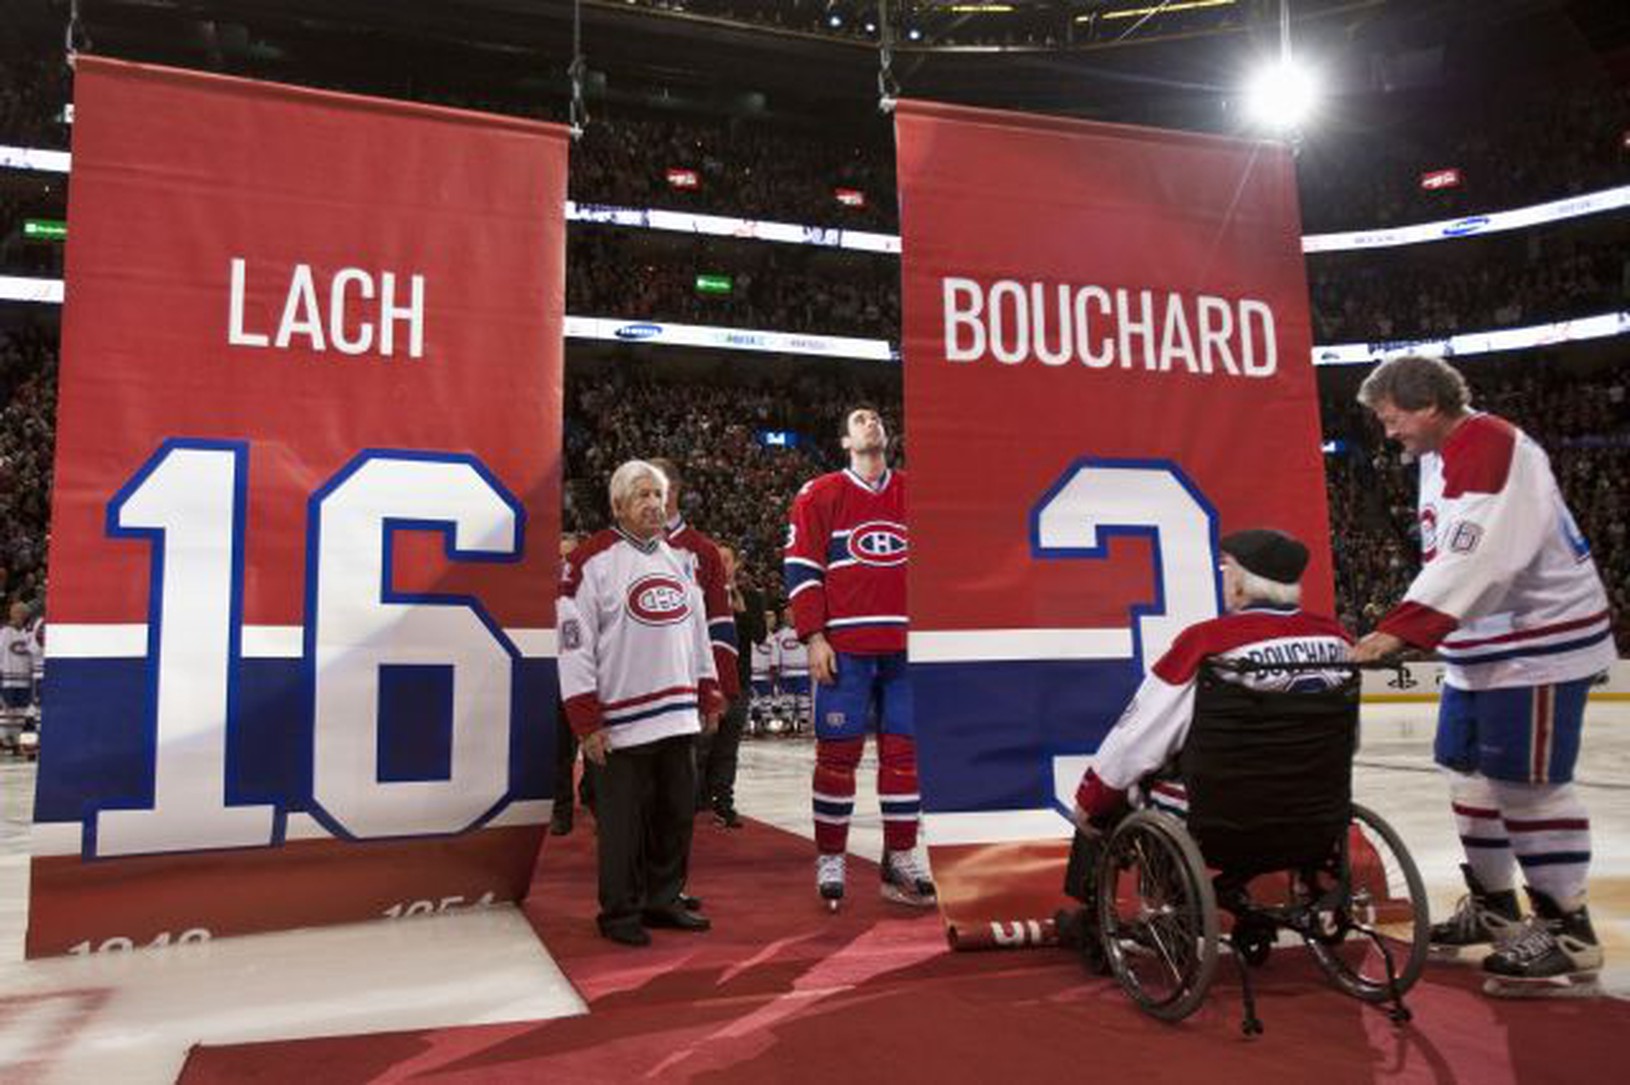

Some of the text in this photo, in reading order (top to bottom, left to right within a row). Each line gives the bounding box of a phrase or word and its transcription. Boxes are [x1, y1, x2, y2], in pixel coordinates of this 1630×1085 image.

[227, 258, 425, 358] LACH
[941, 277, 1278, 378] BOUCHARD
[82, 437, 528, 862] 16
